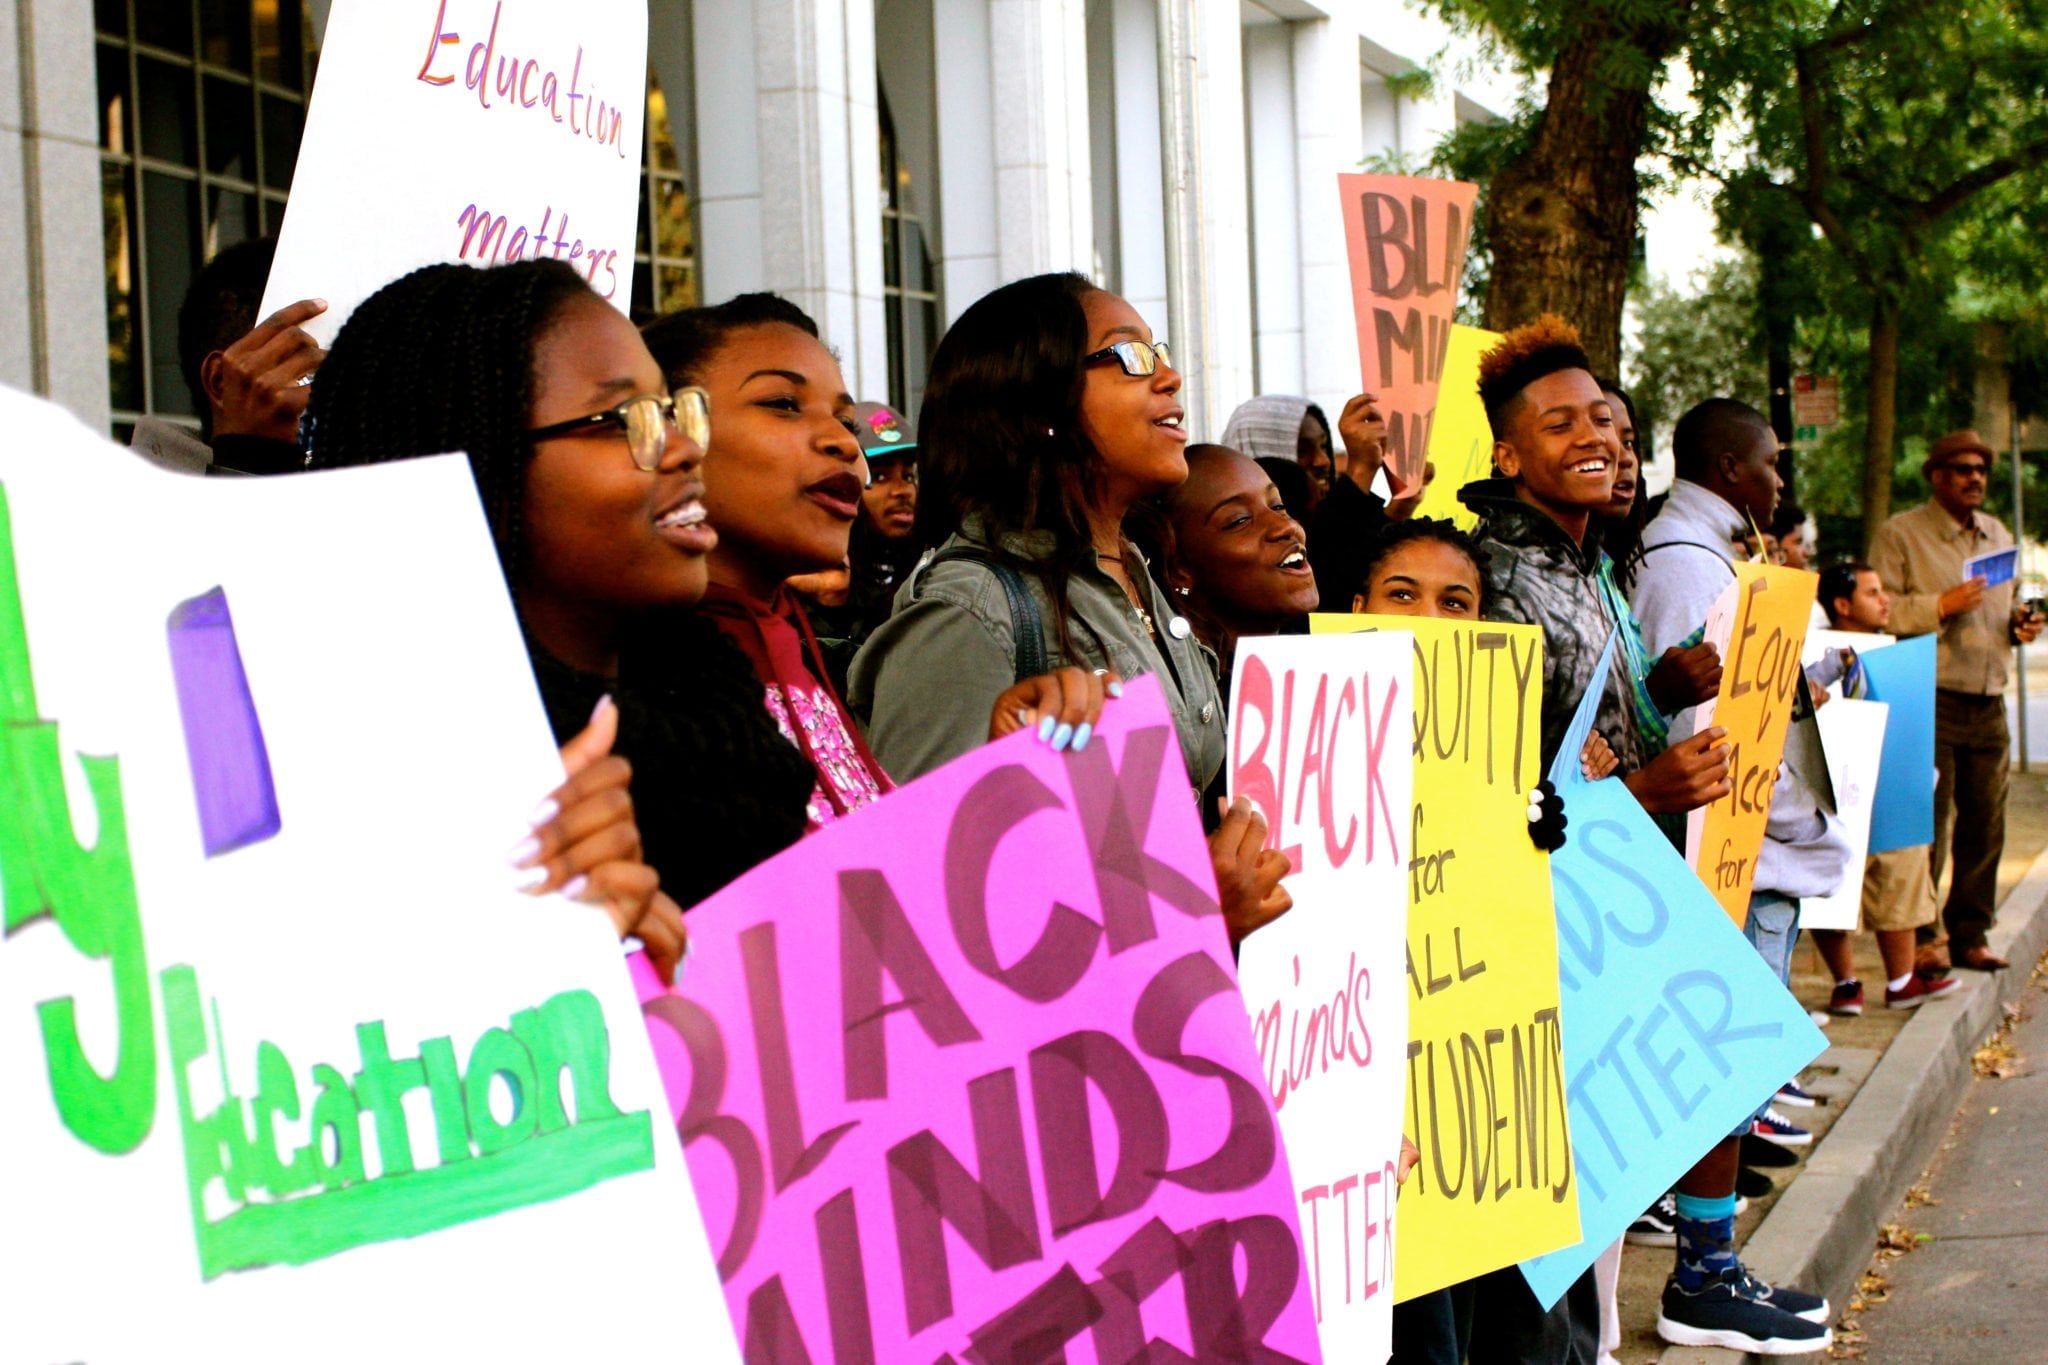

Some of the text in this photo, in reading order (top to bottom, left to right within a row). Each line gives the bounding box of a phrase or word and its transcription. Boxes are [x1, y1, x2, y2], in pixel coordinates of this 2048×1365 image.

[417, 0, 625, 158] Education
[1232, 654, 1399, 874] BLACK
[1408, 802, 1456, 905] for
[1715, 838, 1747, 890] for
[1398, 1007, 1570, 1205] TUDENTS
[1567, 969, 1783, 1202] TTER
